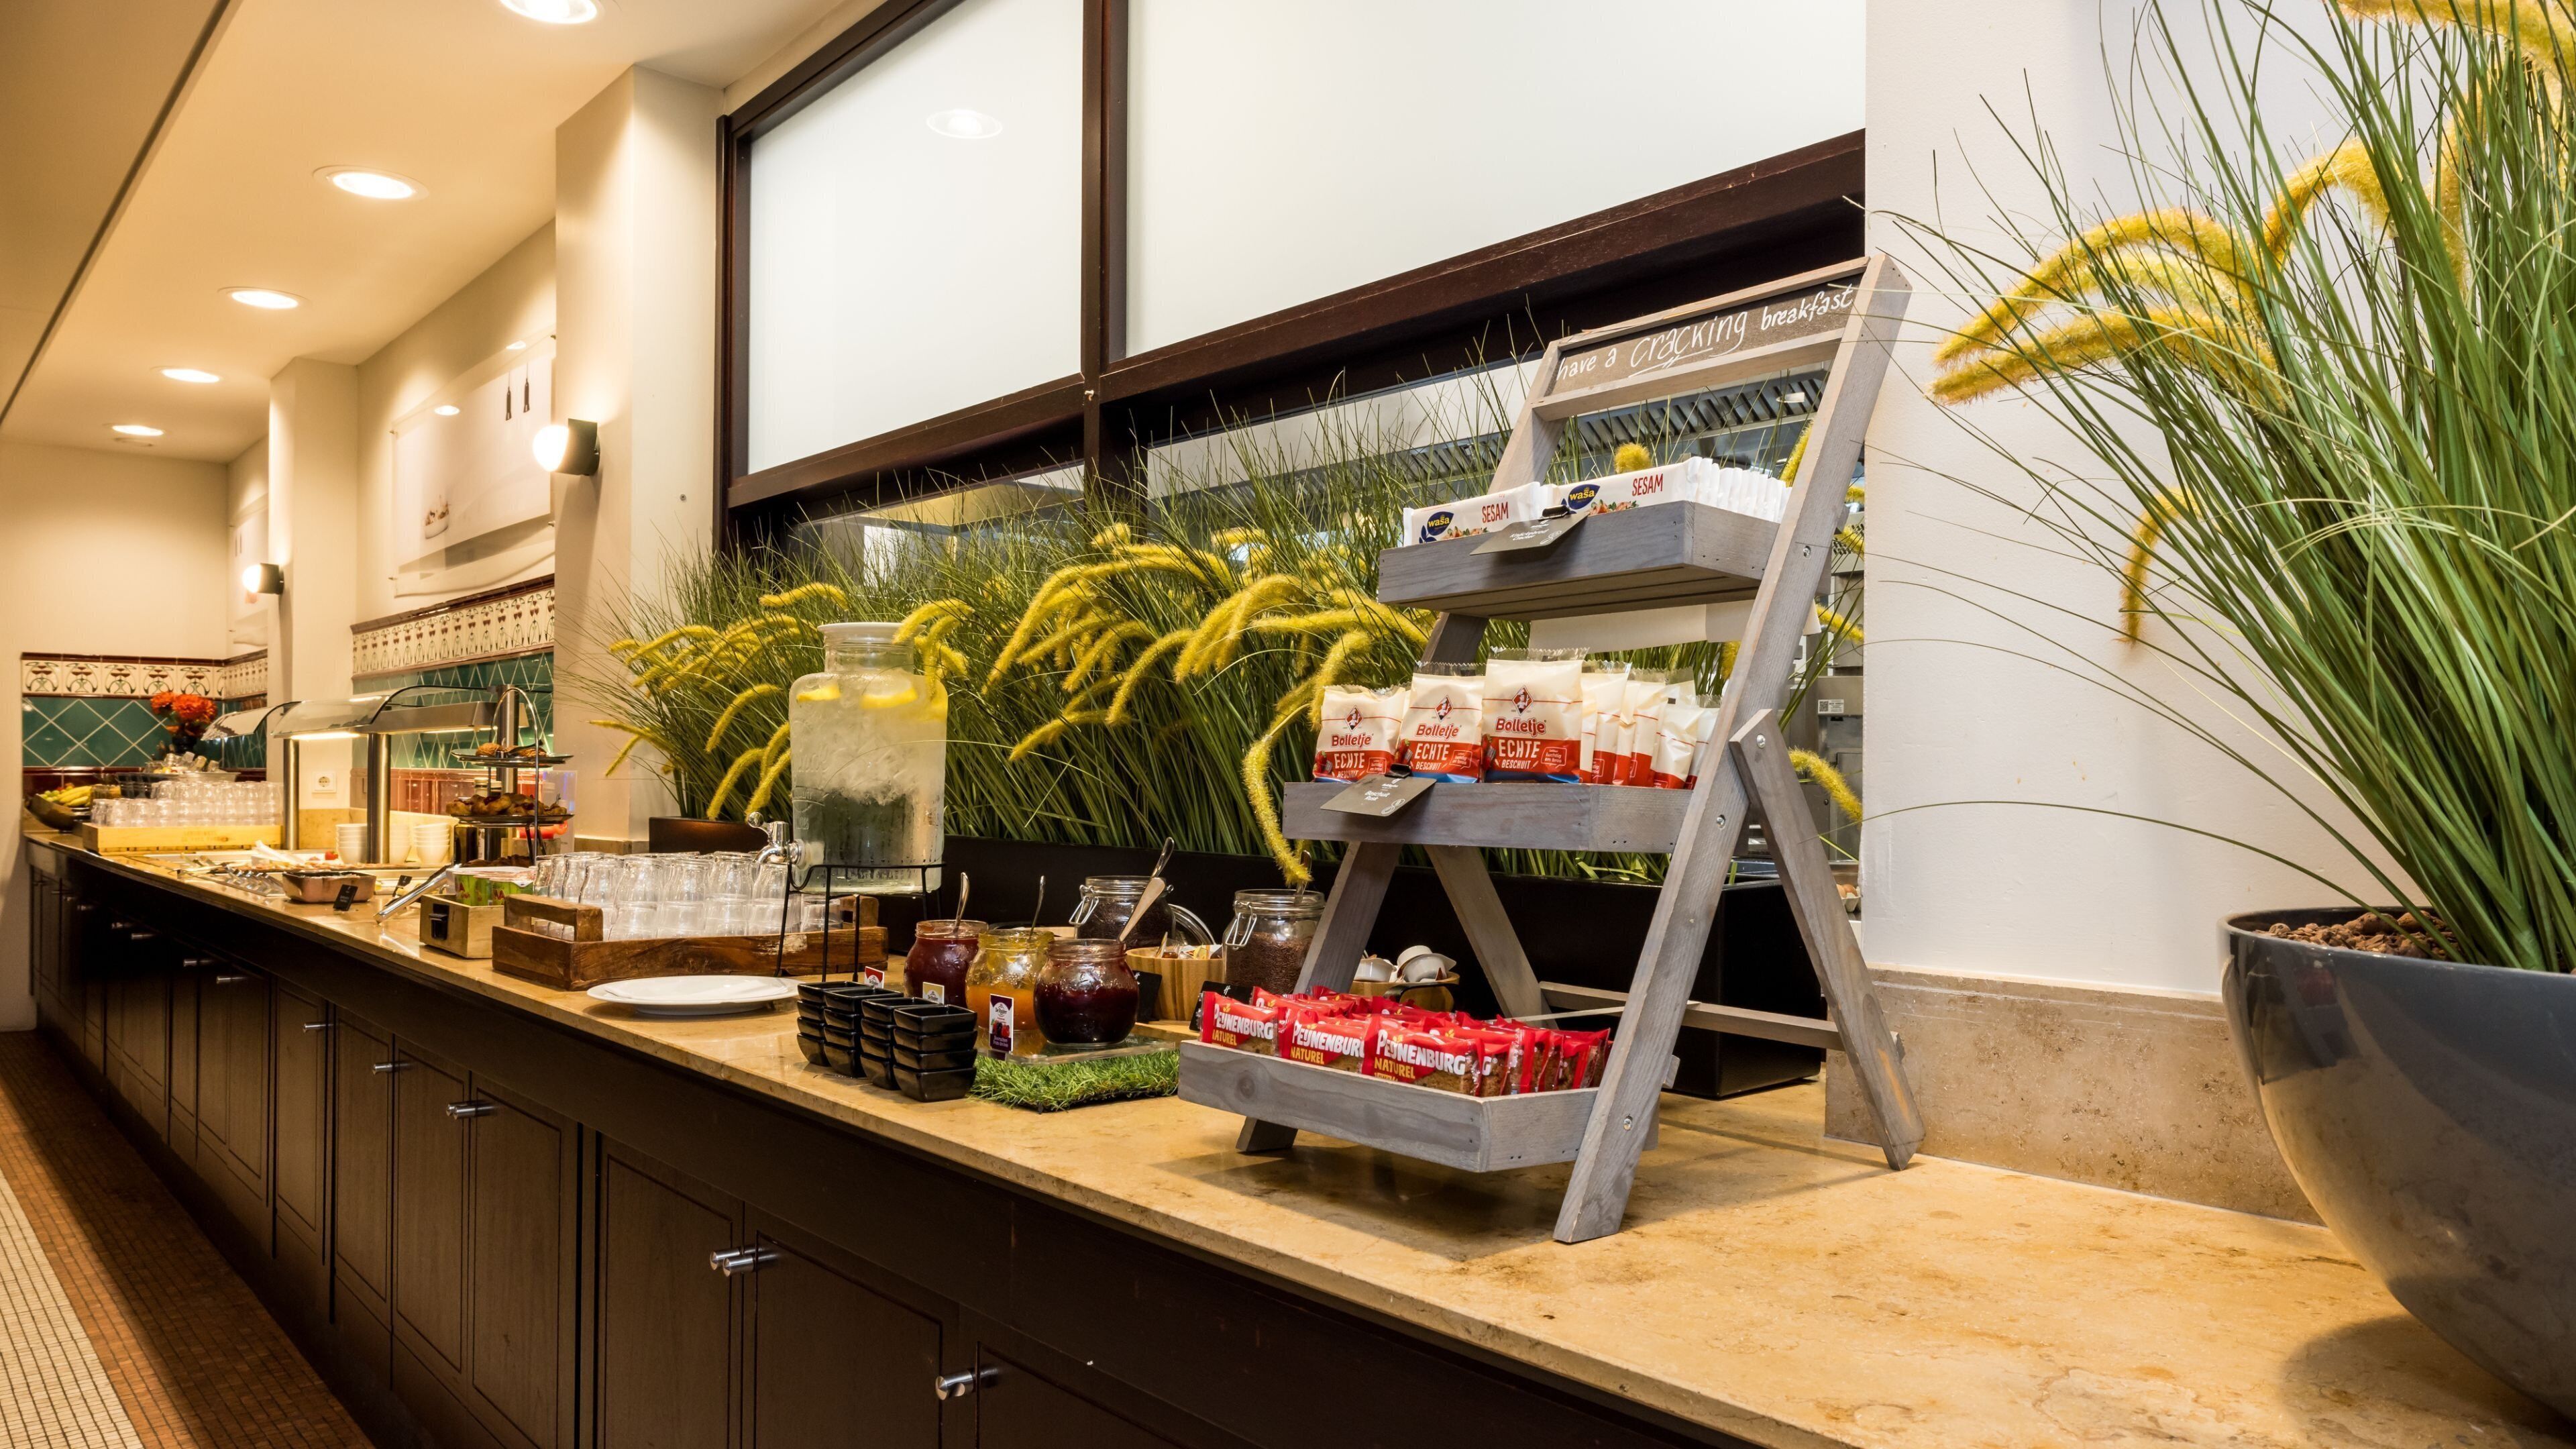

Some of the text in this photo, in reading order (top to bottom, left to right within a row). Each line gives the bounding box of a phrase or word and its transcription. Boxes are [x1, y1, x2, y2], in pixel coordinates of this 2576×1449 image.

[1556, 356, 1597, 381] have
[1605, 347, 1617, 368] a
[1761, 284, 1853, 330] breakfast
[1569, 489, 1595, 500] wasa
[1632, 474, 1664, 496] SESAM
[1428, 517, 1450, 527] wasa
[1482, 502, 1509, 523] SESAM
[1415, 722, 1459, 739] Bolletje
[1495, 718, 1546, 737] Bolletje
[1331, 733, 1371, 749] Bolletje
[1498, 739, 1541, 759] ECHTE
[1334, 752, 1365, 769] ECHTE
[1414, 743, 1450, 761] ECHTE
[1415, 761, 1442, 771] BESCHUIT
[1501, 759, 1532, 769] BESCHUIT
[1214, 1003, 1274, 1040] PEIJNENBURG
[1290, 1046, 1325, 1065] NATUREL
[1376, 1029, 1466, 1075] PEIJNENBURG
[1374, 1057, 1416, 1079] NATUREL
